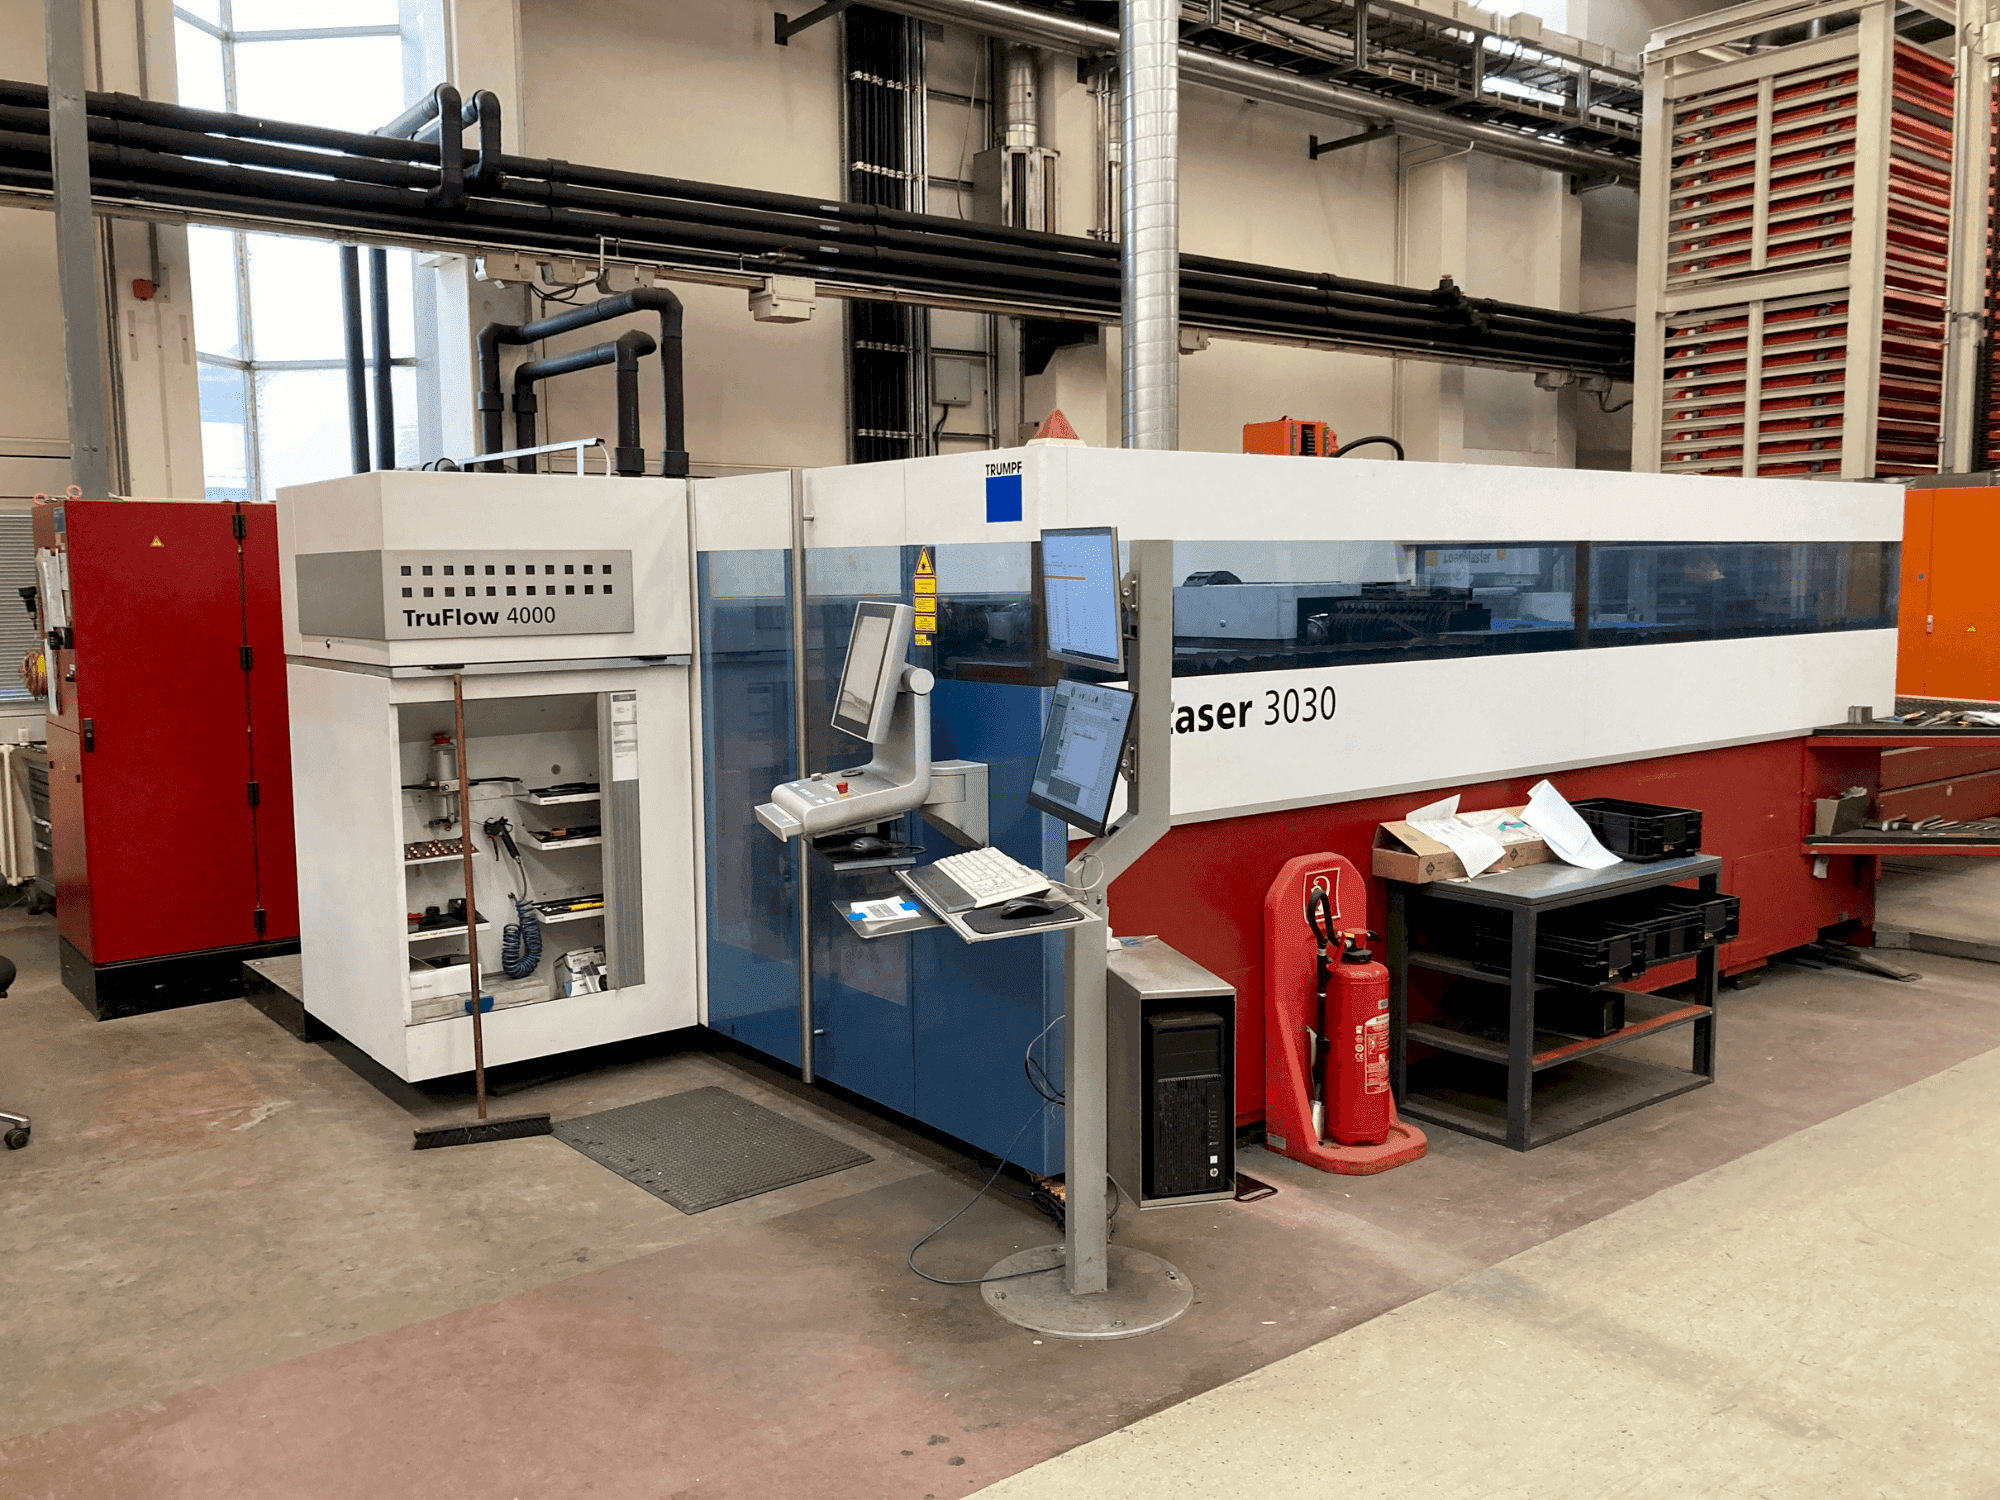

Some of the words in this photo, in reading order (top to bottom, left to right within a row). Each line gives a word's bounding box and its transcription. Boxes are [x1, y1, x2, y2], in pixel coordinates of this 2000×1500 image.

[985, 461, 1022, 476] TRUMPF
[403, 608, 499, 627] TruFlow
[507, 606, 556, 624] 4000
[1171, 700, 1253, 735] aser
[1264, 686, 1336, 726] 3030
